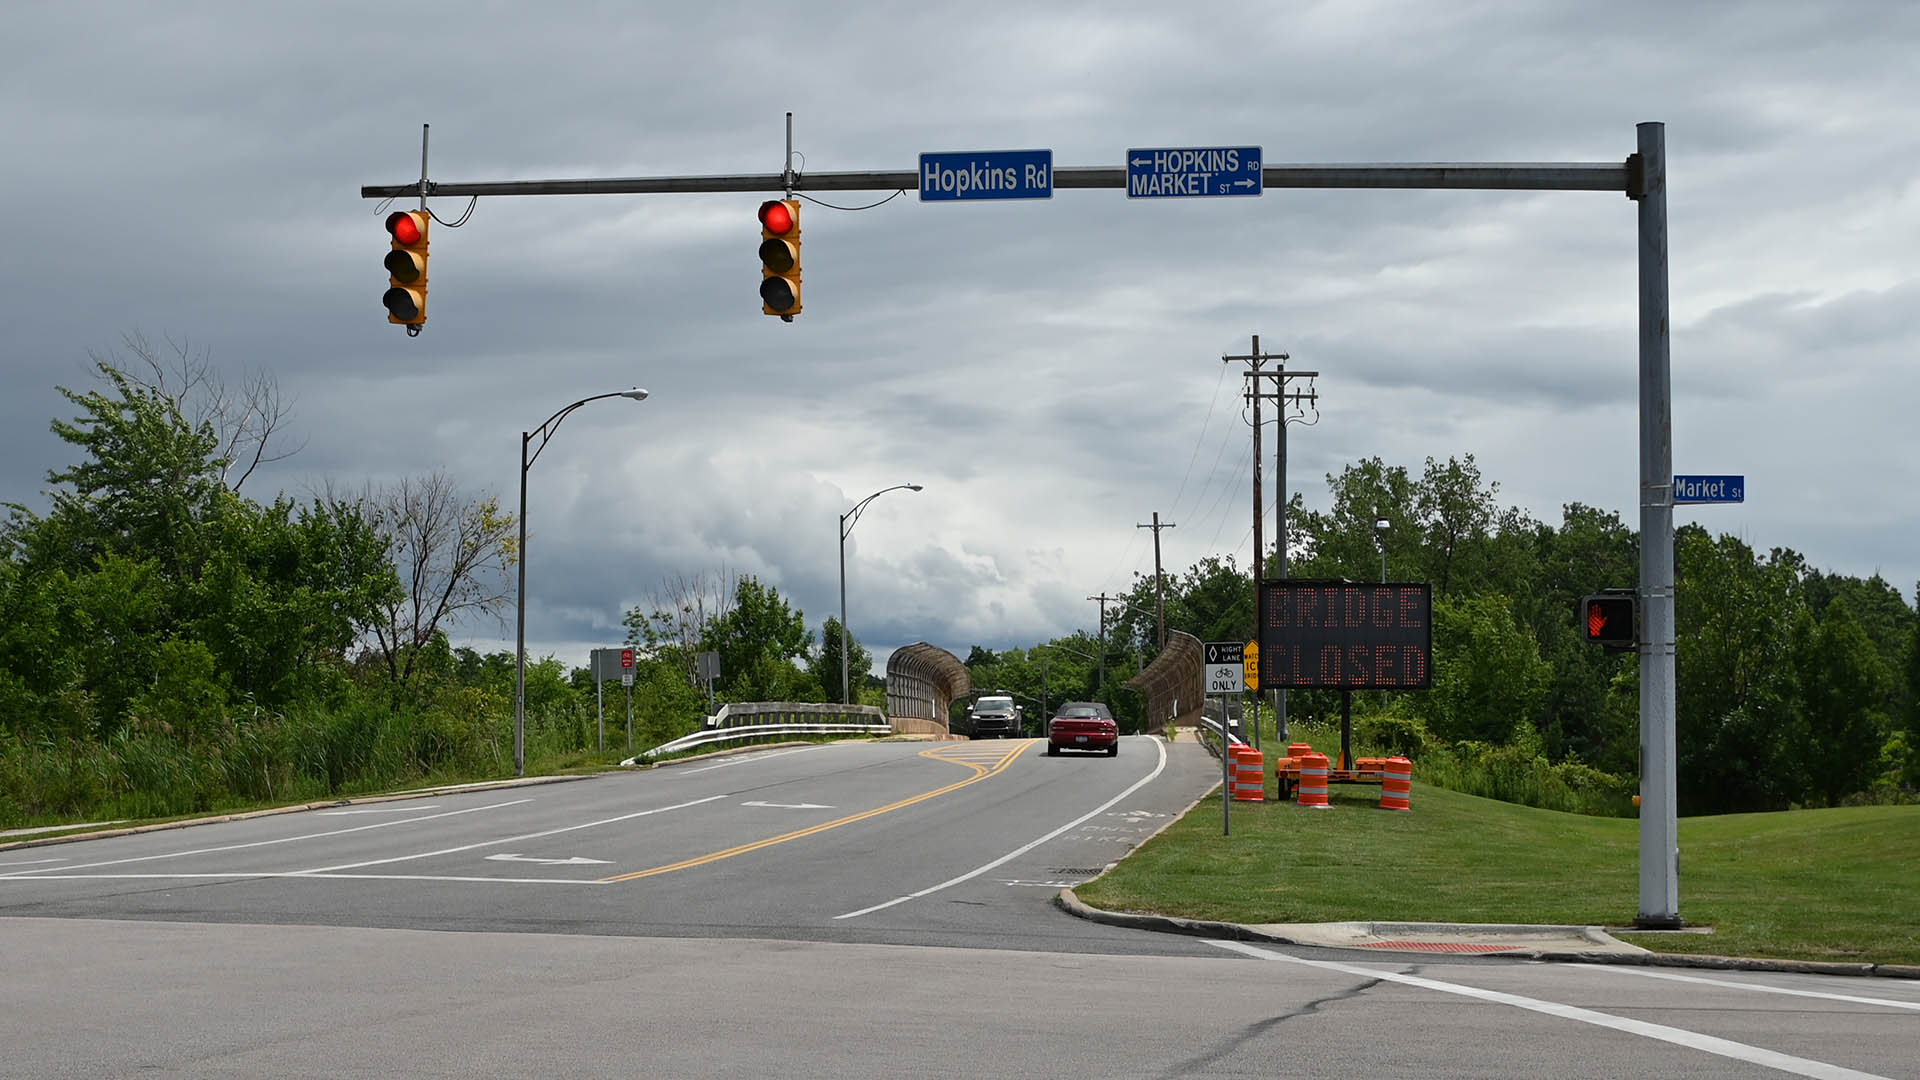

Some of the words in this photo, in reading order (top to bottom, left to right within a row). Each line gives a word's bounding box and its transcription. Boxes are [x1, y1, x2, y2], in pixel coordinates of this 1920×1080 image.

[1154, 149, 1239, 173] HOPKINS
[1247, 160, 1260, 171] RD
[924, 160, 1018, 197] Hopkins
[1025, 163, 1047, 189] Rd
[1132, 173, 1212, 195] MARKET
[1219, 183, 1231, 194] ST
[1675, 478, 1726, 497] Market
[1731, 487, 1742, 498] St
[1269, 587, 1423, 628] BRIDGE
[1266, 644, 1425, 685] CLOSED
[1212, 680, 1237, 690] ONLY
